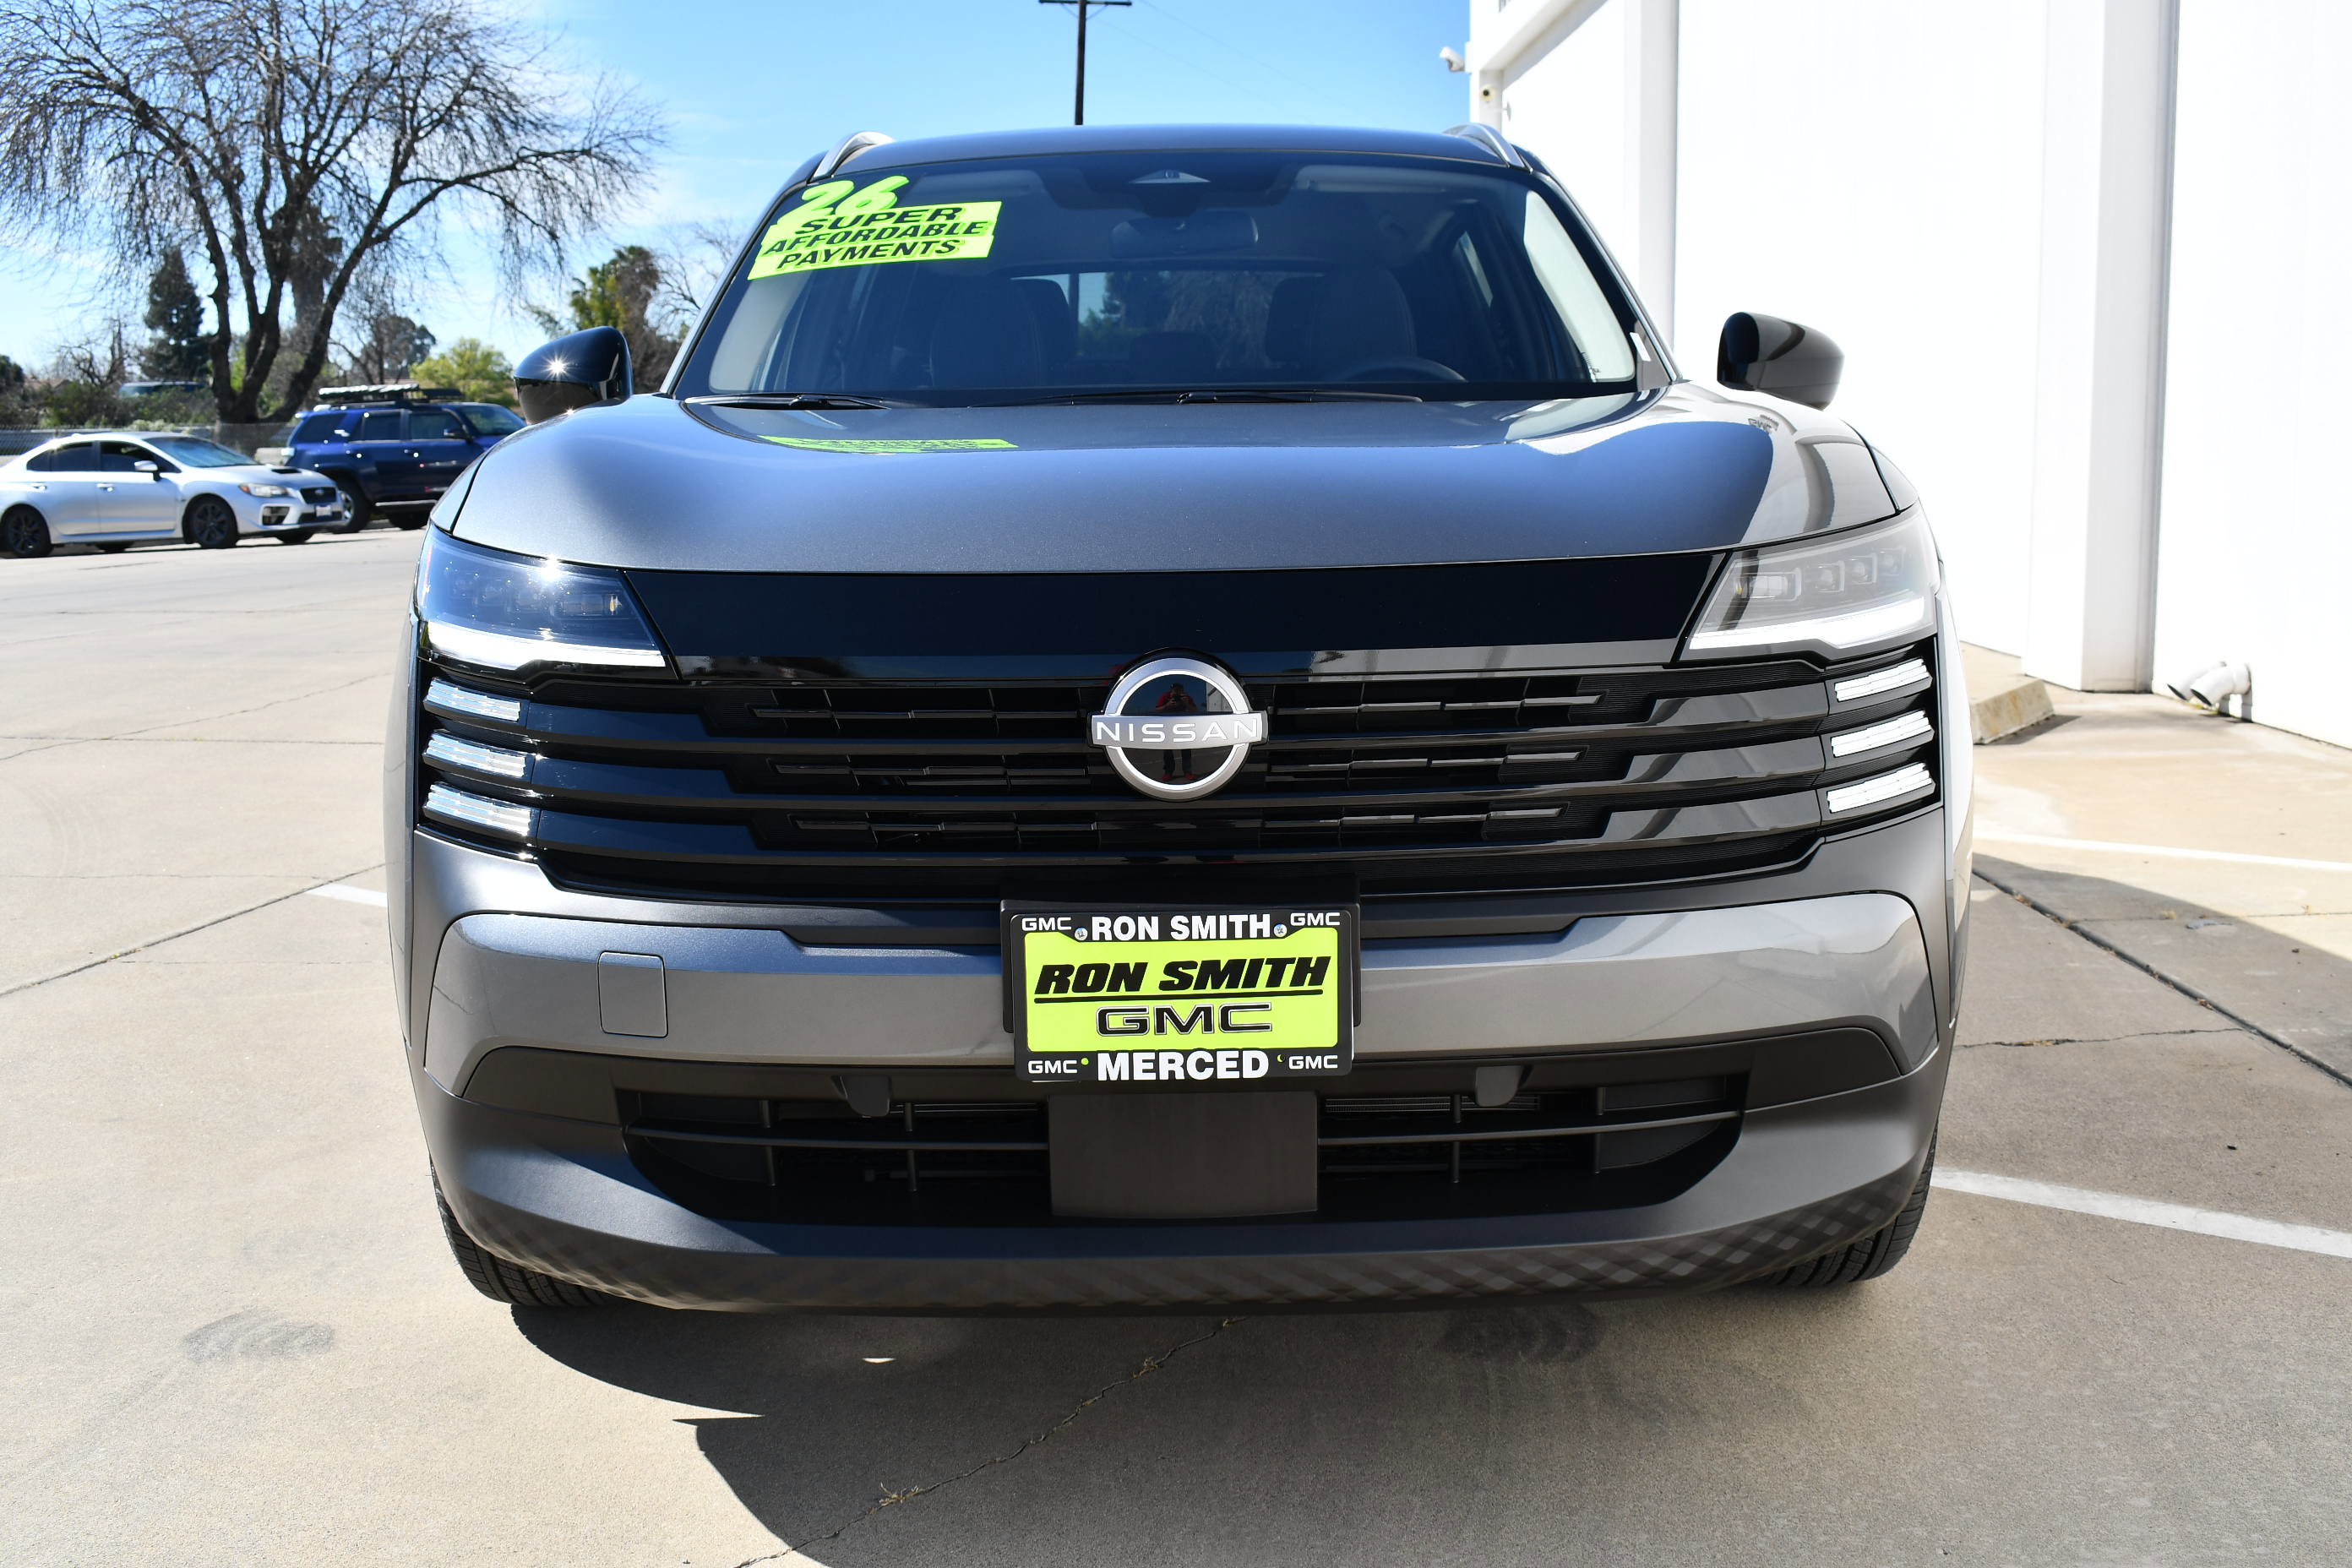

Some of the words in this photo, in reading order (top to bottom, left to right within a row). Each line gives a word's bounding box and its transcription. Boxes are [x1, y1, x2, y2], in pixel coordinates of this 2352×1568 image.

[778, 175, 910, 220] 26
[794, 206, 964, 235] SUPER
[762, 220, 988, 257] AFFORDABLE
[776, 239, 961, 270] PAYMENTS
[1097, 719, 1257, 742] NISSAN
[1021, 917, 1072, 932] GMC
[1092, 916, 1160, 941] RON
[1170, 914, 1271, 940] SMITH
[1289, 912, 1341, 927] GMC
[1034, 961, 1148, 995] RON
[1158, 956, 1332, 993] SMITH
[1096, 1001, 1272, 1037] GMC
[1027, 1059, 1078, 1075] GMC
[1097, 1049, 1269, 1081] MERCED
[1288, 1054, 1338, 1070] GMC
